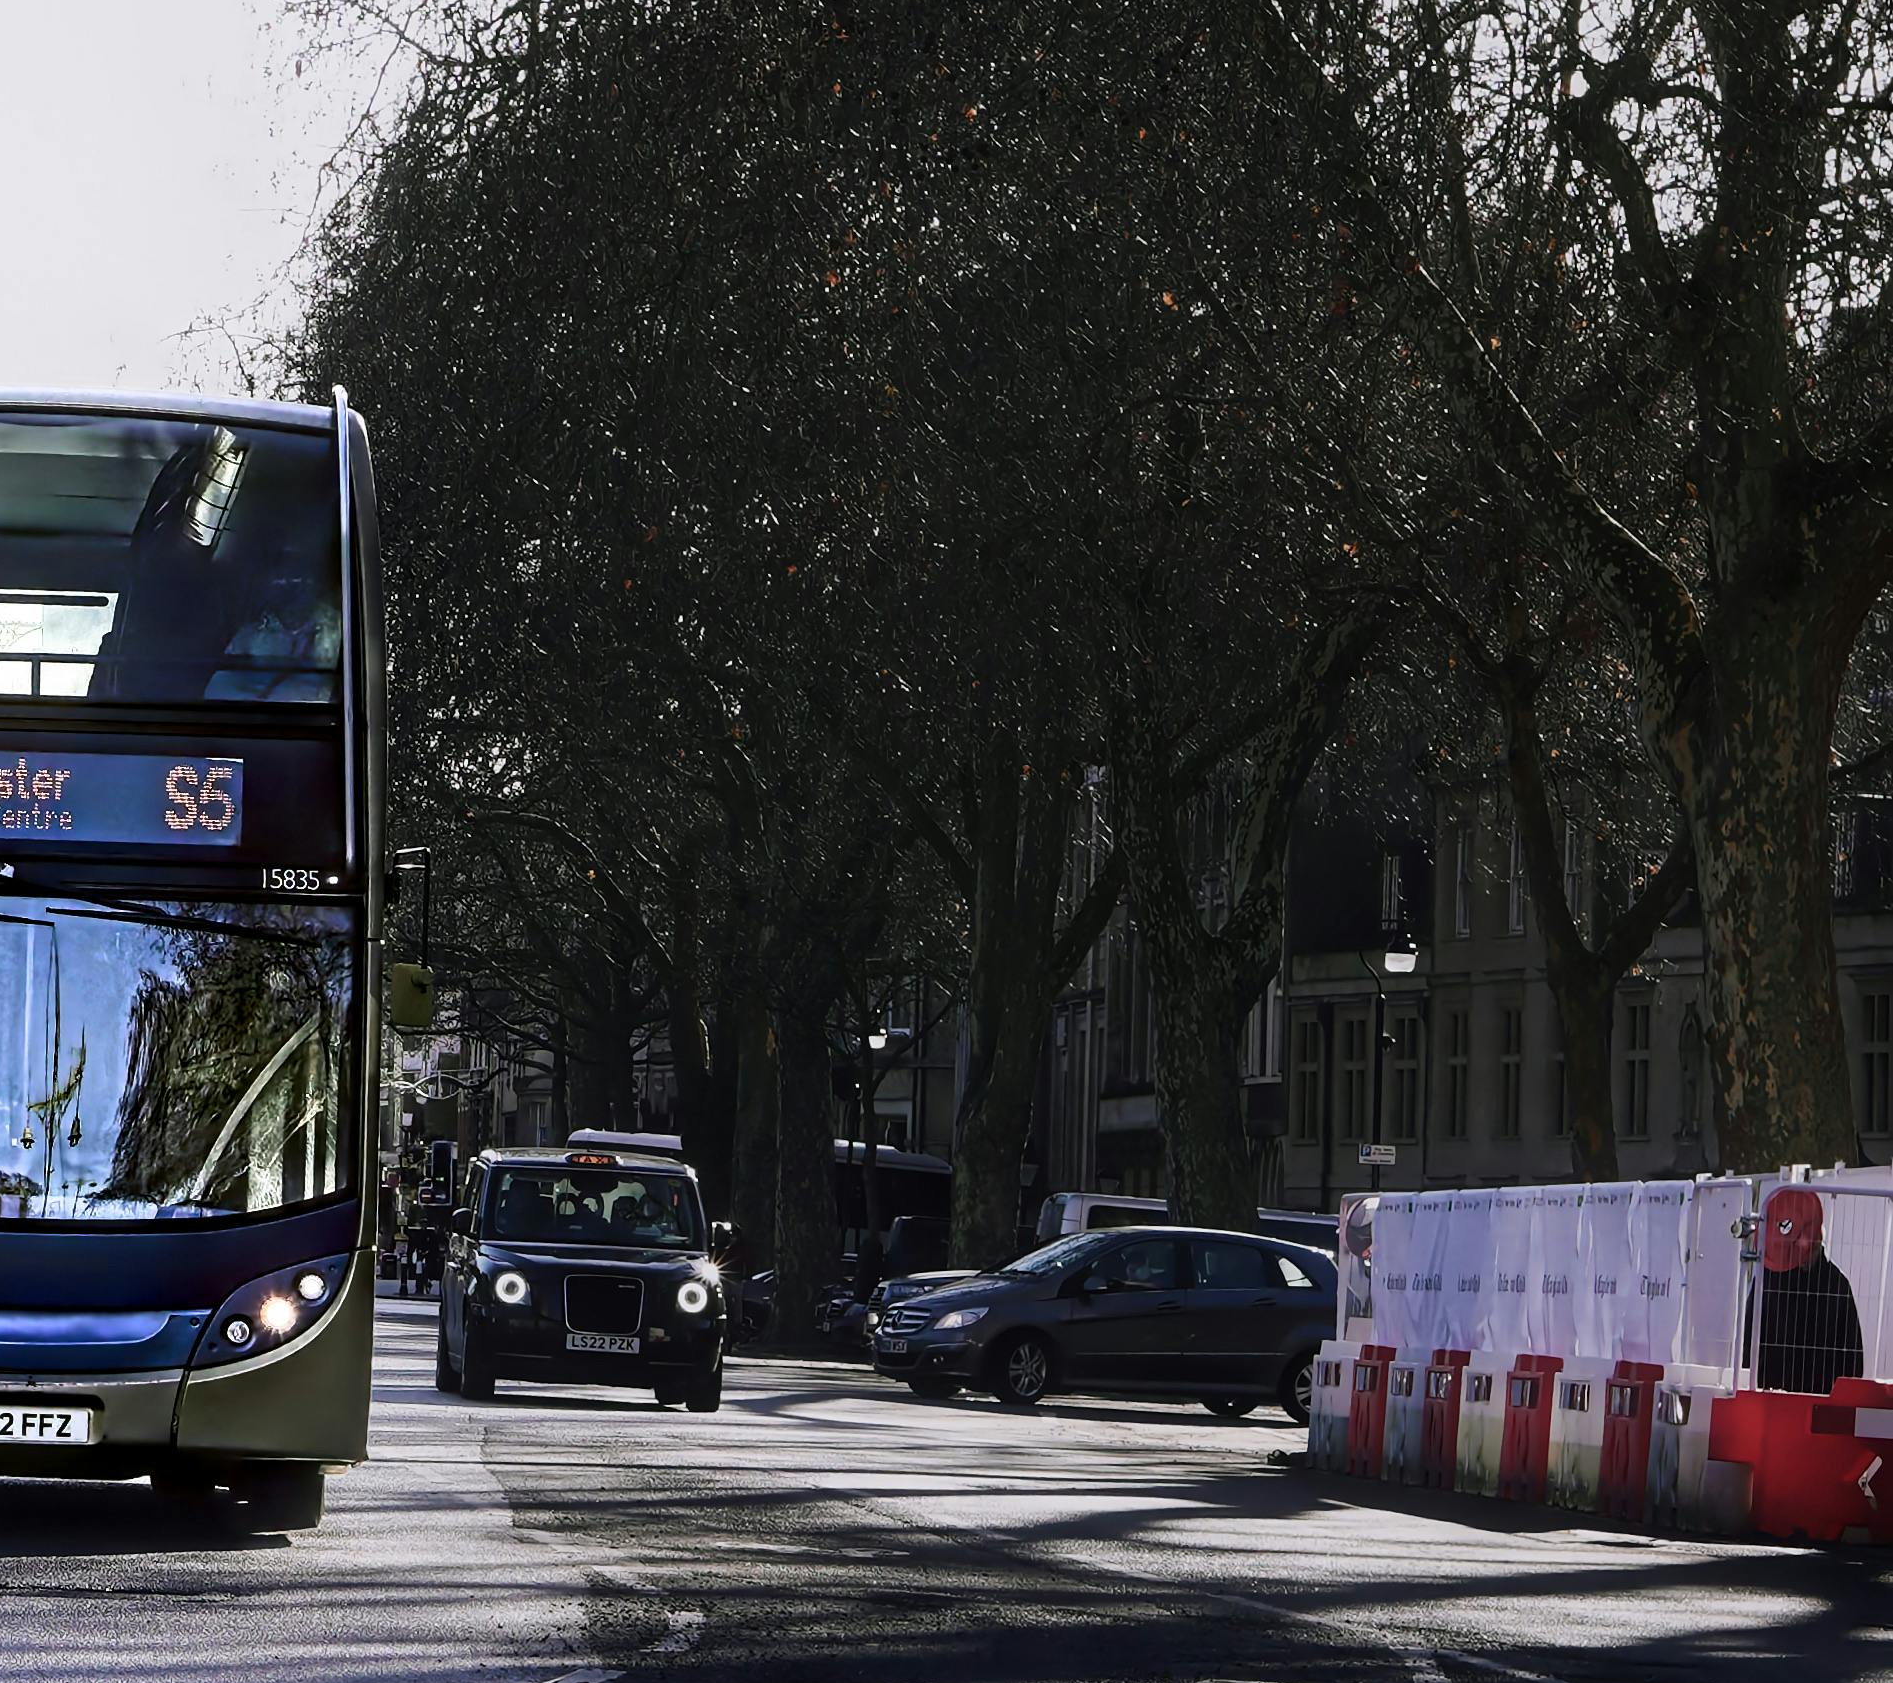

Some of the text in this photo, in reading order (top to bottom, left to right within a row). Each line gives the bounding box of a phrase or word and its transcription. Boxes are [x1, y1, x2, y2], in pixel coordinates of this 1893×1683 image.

[165, 765, 235, 830] S5
[262, 868, 320, 891] 15835
[576, 1155, 611, 1165] TAXI
[571, 1335, 635, 1350] LS22 PZK
[21, 1413, 72, 1438] FFZ
